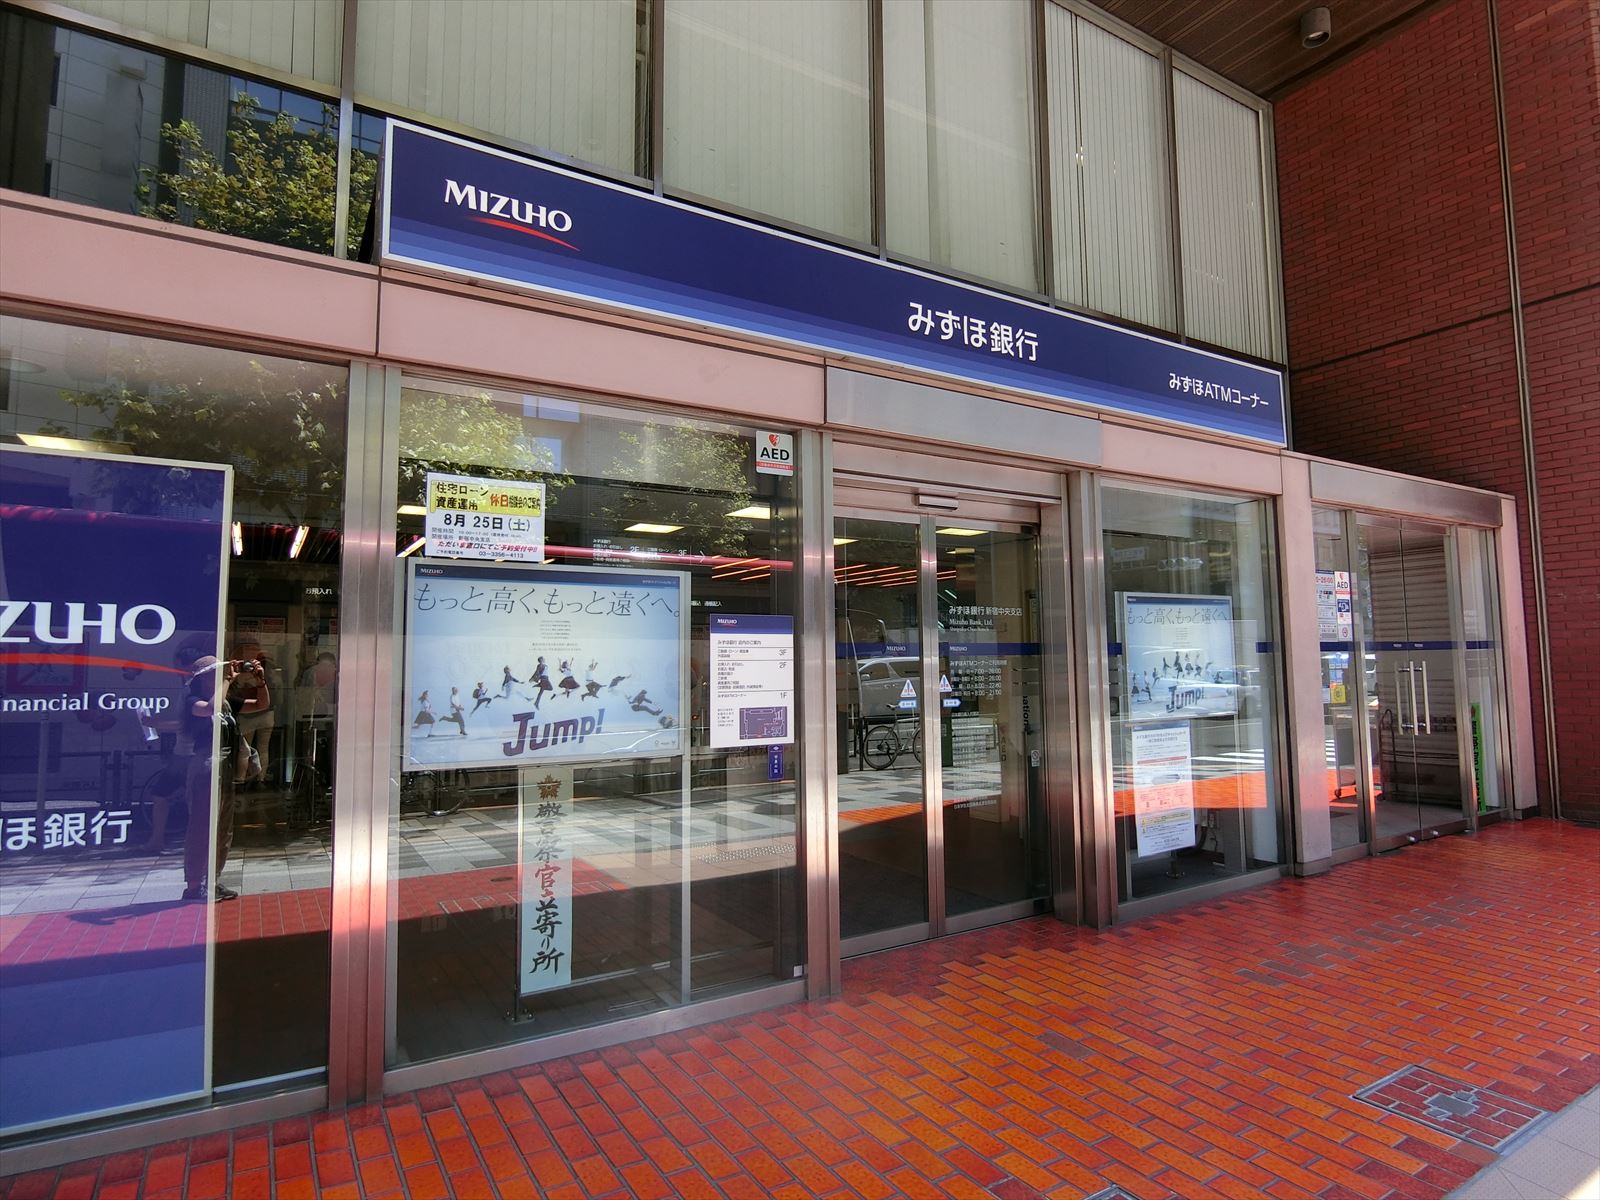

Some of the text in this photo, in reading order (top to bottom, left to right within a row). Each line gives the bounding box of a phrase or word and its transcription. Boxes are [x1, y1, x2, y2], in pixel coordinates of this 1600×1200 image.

[444, 178, 573, 232] MIZUHO
[908, 302, 1039, 361] みずほ銀行
[1169, 372, 1269, 408] みずほATMコーナー
[760, 447, 790, 461] AED
[436, 482, 489, 497] 住宅ローン
[436, 496, 478, 511] 資産運用
[444, 513, 466, 527] 8月
[1336, 581, 1348, 589] AED
[414, 583, 680, 618] もっと高く、もっと遠くへ。
[949, 605, 985, 616] みずほ銀行
[98, 692, 170, 714] Group
[1165, 685, 1205, 714] Jump!
[502, 708, 606, 757] Jump!
